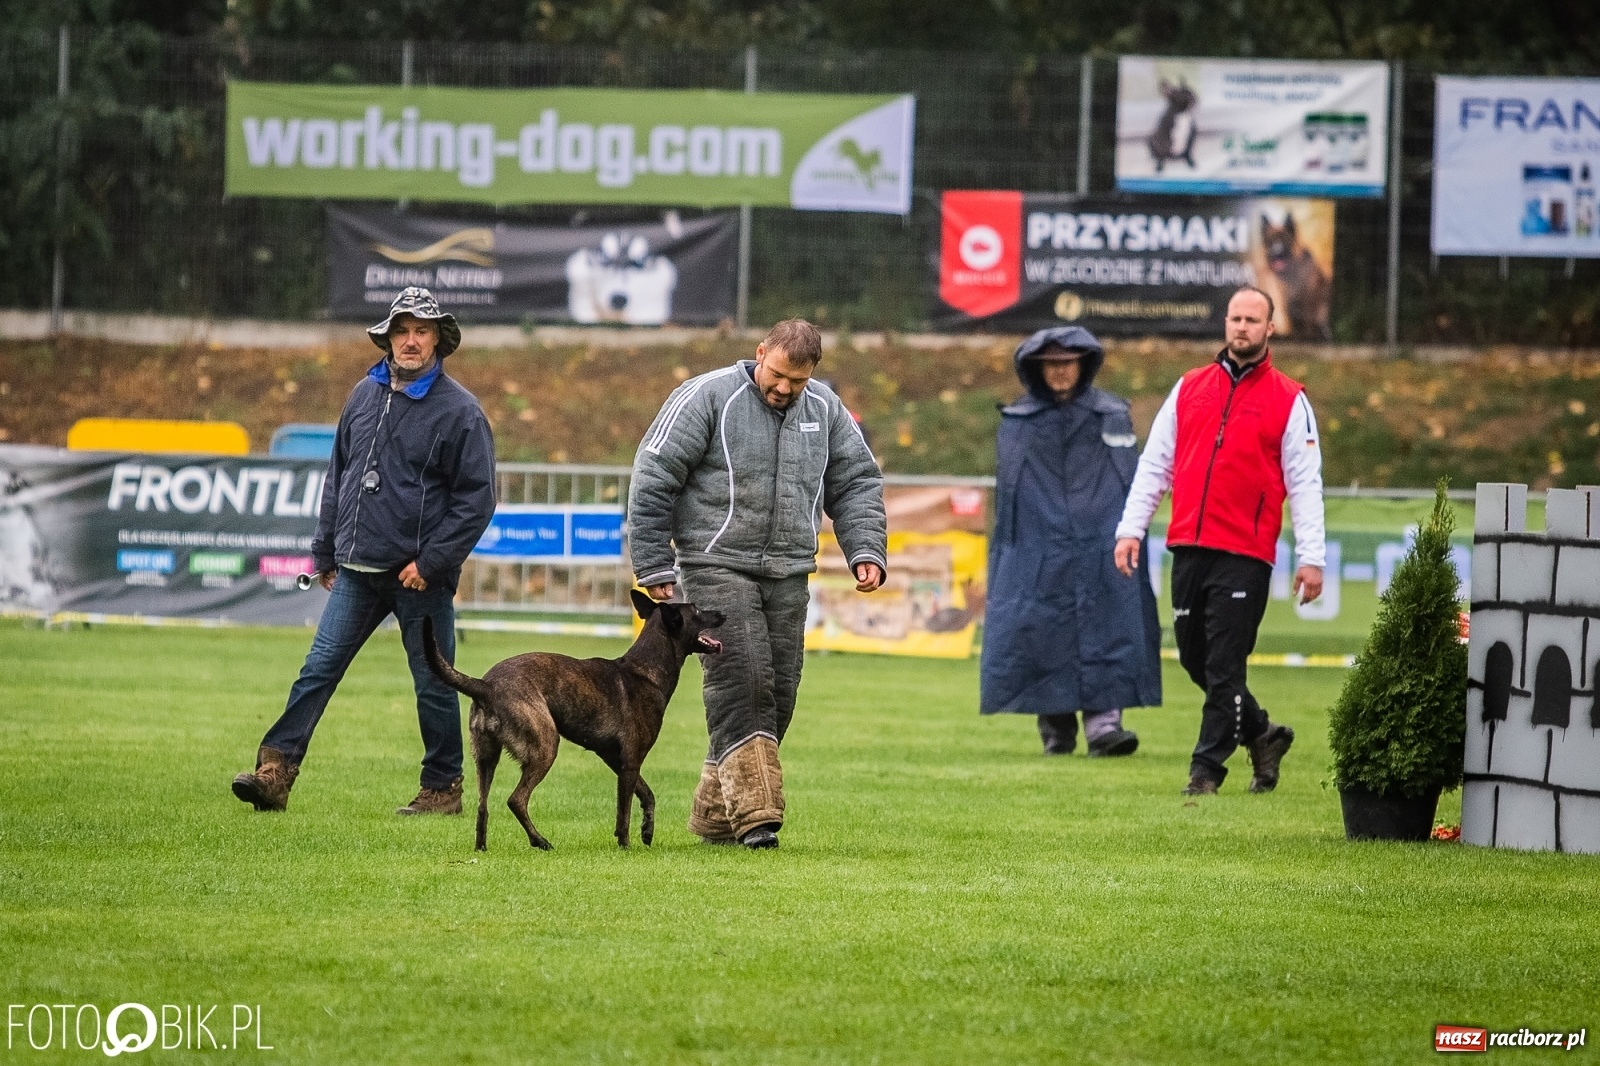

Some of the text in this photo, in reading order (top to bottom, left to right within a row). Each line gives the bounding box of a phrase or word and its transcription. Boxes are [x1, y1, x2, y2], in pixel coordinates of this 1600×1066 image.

[242, 106, 783, 188] working-dog.com
[1027, 212, 1250, 252] PRZYSMAKI
[1051, 257, 1144, 285] ZGODZIE
[107, 464, 328, 517] FRONTLI
